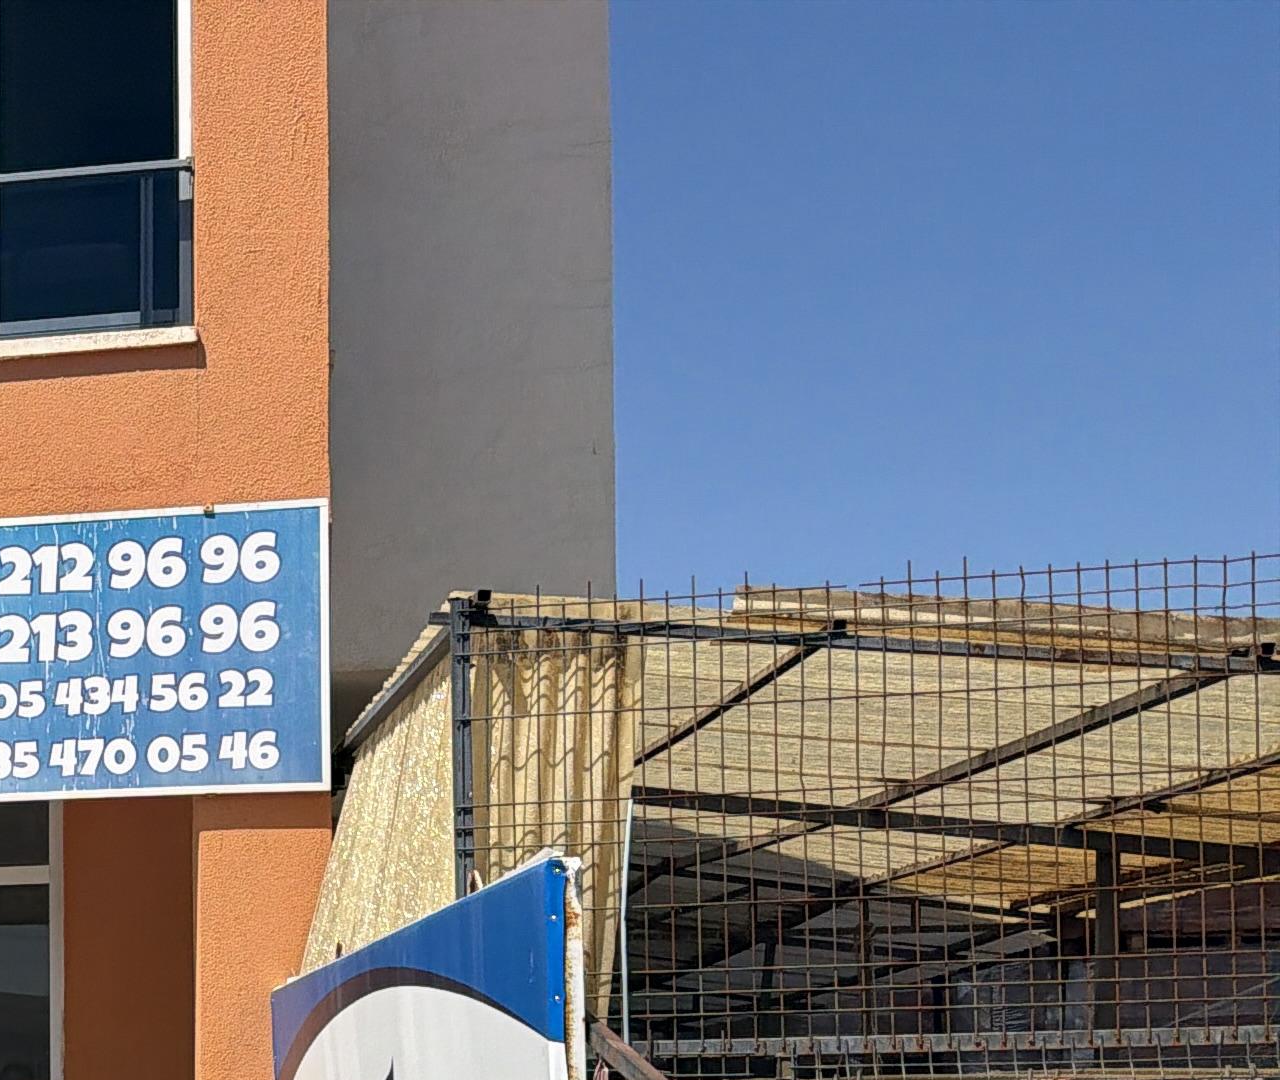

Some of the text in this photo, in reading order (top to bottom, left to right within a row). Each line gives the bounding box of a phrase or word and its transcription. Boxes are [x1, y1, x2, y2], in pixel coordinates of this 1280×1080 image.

[108, 536, 187, 590] 96
[200, 531, 281, 585] 96
[107, 606, 187, 658] 96
[199, 600, 281, 654] 96
[55, 674, 139, 717] 434
[148, 671, 209, 713] 56
[218, 667, 274, 708] 22
[48, 735, 137, 778] 470
[147, 733, 209, 774] 05
[218, 729, 280, 771] 46
